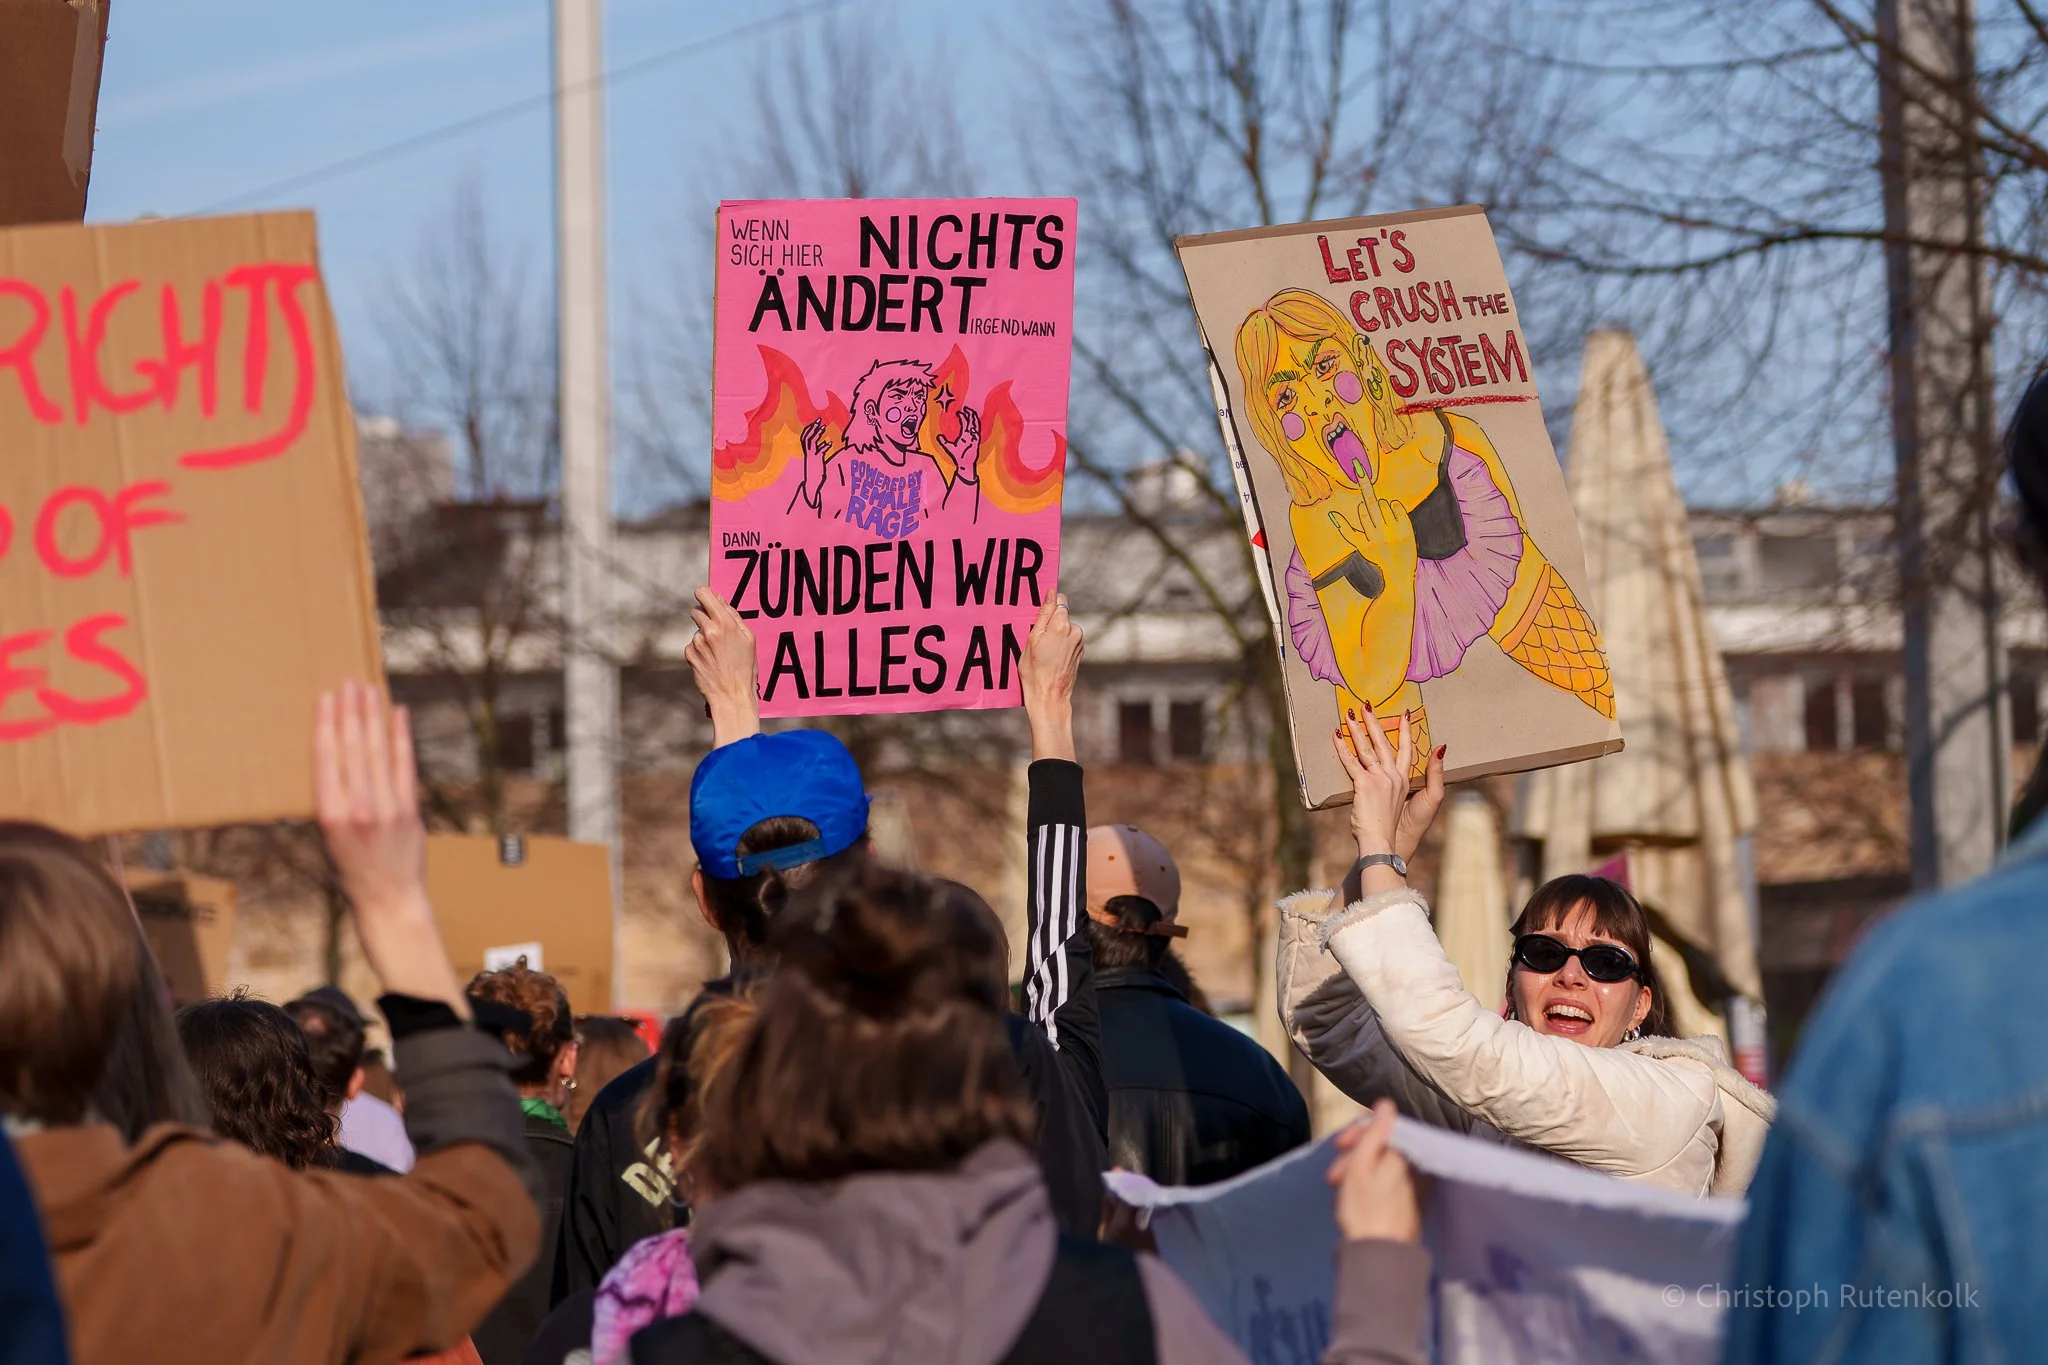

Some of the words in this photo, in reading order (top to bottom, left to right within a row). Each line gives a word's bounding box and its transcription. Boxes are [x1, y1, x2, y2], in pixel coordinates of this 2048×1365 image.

[730, 218, 789, 241] WENN
[730, 243, 773, 267] SICH
[782, 243, 824, 267] HIER
[859, 212, 1064, 271] NICHTS
[1317, 229, 1415, 284] LET'S
[748, 267, 987, 334] ÄNDERT
[970, 317, 1055, 337] IRGENDWANN
[1350, 280, 1462, 332] CRUSH
[1462, 293, 1509, 316] THE
[0, 262, 318, 470] RIGHTS
[1386, 330, 1528, 398] SYSTEM
[851, 459, 906, 492] POWERED
[908, 469, 923, 488] BY
[851, 476, 921, 510] FEMALE
[33, 481, 188, 578] OF
[722, 531, 761, 548] DANN
[846, 495, 920, 540] RAGE
[724, 540, 935, 619] ZÜNDEN
[952, 537, 1044, 607] WIR
[762, 624, 948, 702] ALLES
